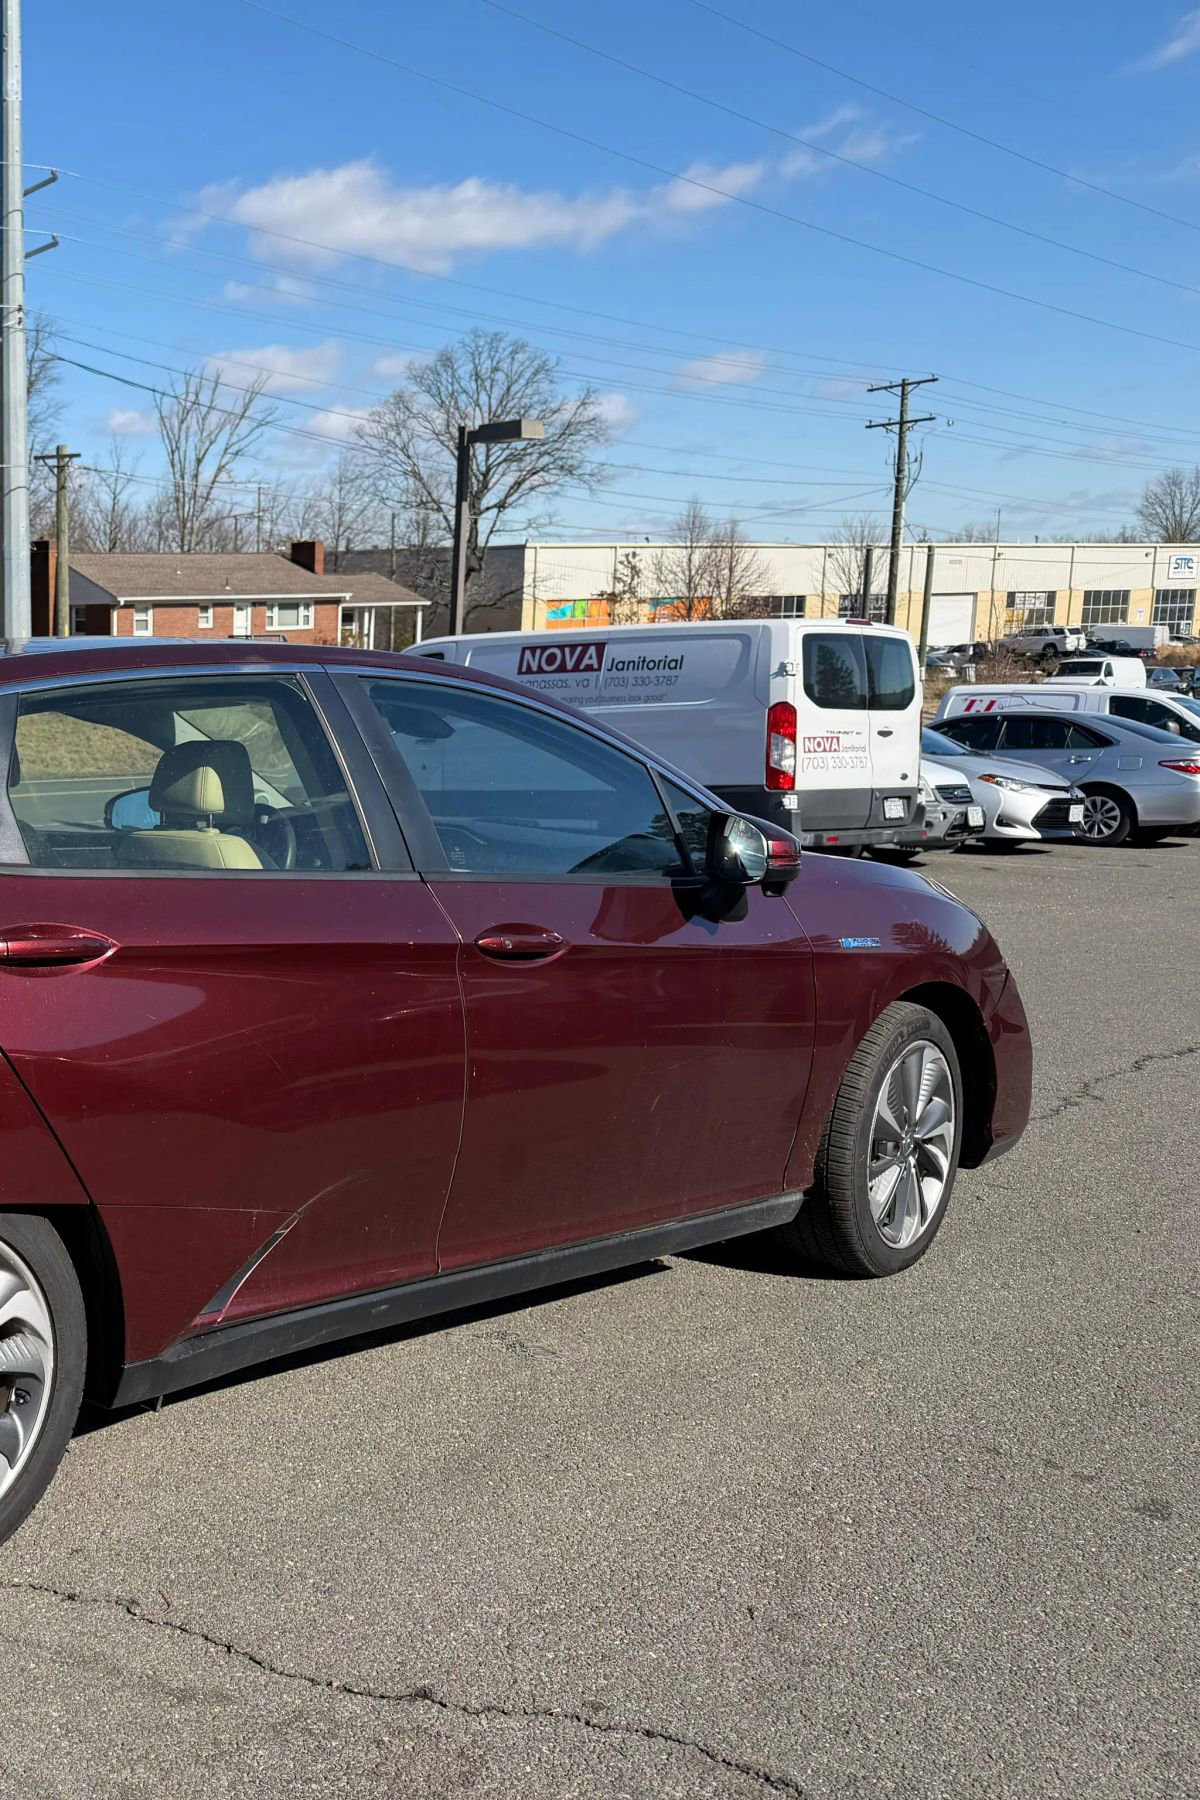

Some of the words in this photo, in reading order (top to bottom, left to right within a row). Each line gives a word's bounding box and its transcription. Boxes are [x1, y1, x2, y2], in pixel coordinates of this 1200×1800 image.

[520, 645, 599, 673] NOVA
[606, 655, 684, 672] Janitorial
[575, 678, 590, 689] va
[604, 676, 629, 690] (703)
[631, 675, 679, 688] 330-3787
[804, 737, 839, 752] NOVA
[841, 744, 867, 753] Janitorial
[801, 756, 829, 773] (703)
[831, 756, 868, 769] 330-3787
